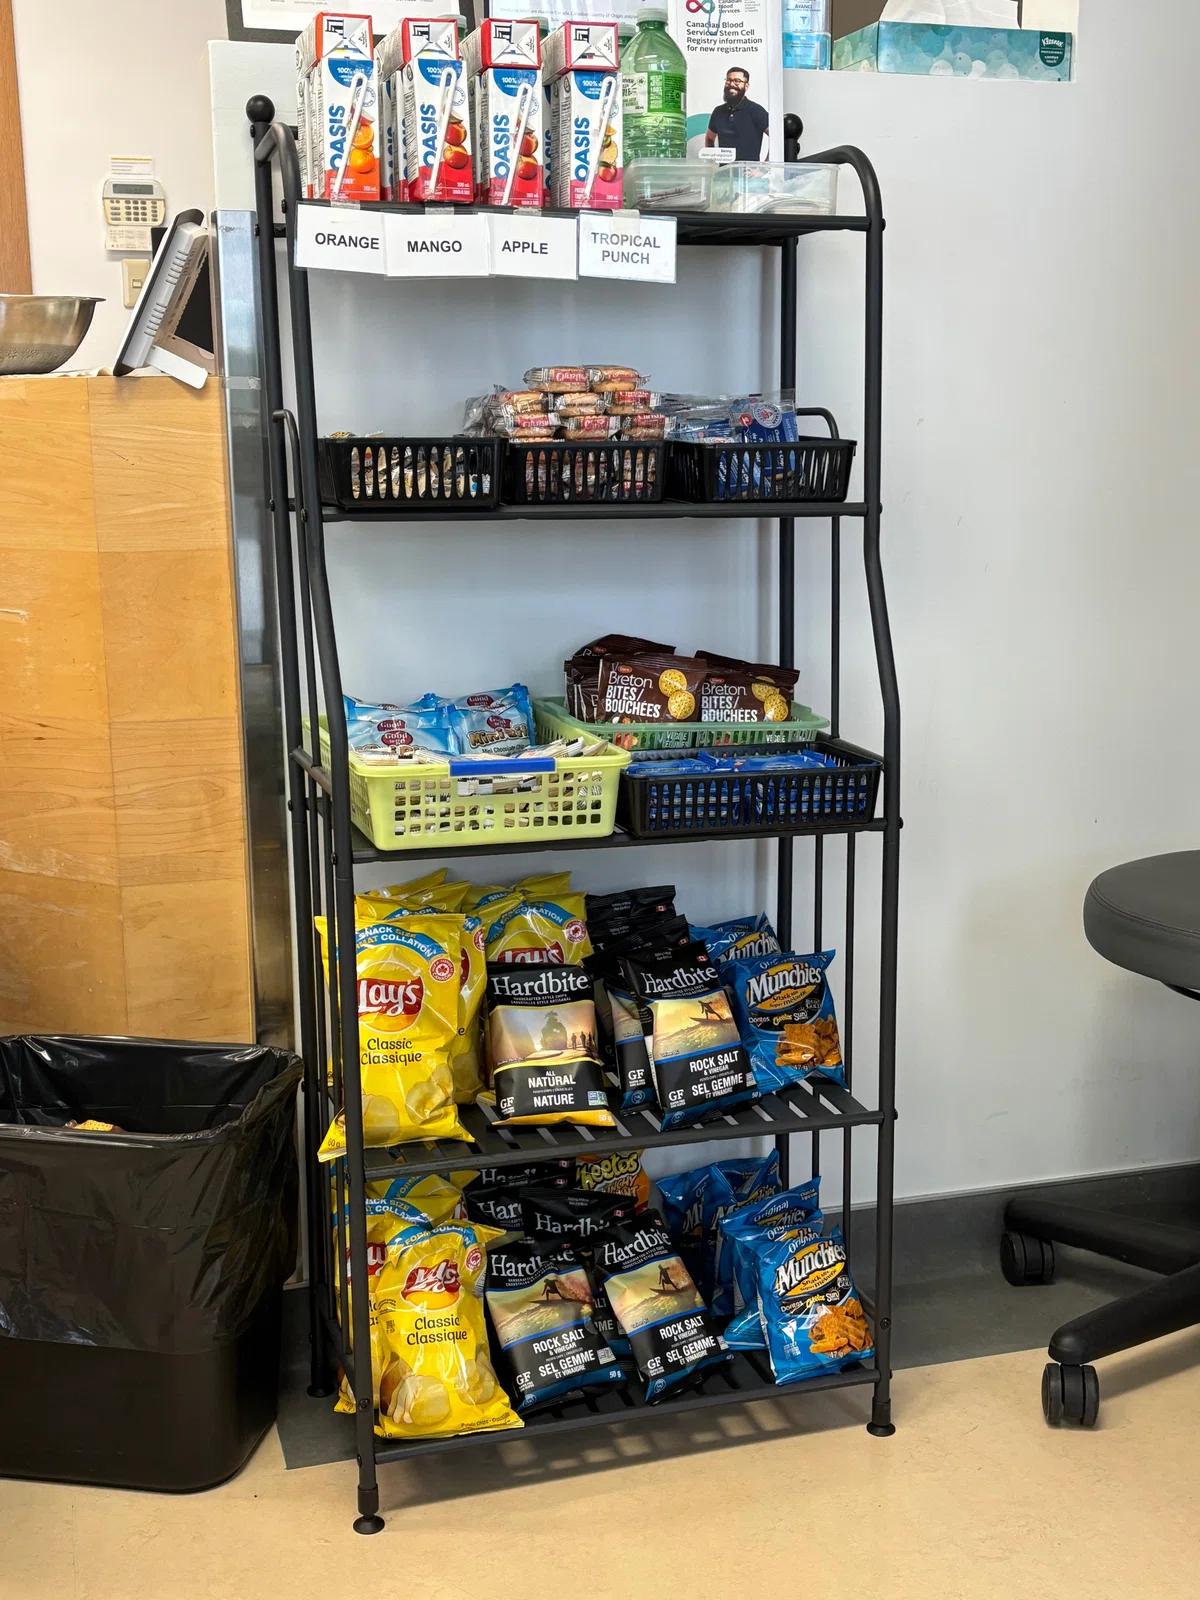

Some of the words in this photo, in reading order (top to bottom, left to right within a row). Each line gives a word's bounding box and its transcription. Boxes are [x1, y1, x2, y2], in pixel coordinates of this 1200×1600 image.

[687, 37, 717, 45] Registry
[717, 45, 759, 53] registrants
[329, 105, 347, 172] OASIS
[420, 104, 438, 168] OASIS
[493, 115, 510, 179] OASIS
[574, 117, 590, 182] OASIS
[315, 232, 380, 250] ORANGE
[407, 240, 462, 253] MANGO
[502, 240, 549, 254] APPLE
[591, 232, 661, 248] TROPICAL
[601, 250, 650, 265] PUNCH
[609, 671, 652, 688] Breton
[606, 685, 644, 701] BITES/
[702, 683, 746, 696] Breton
[606, 699, 661, 718] BOUCHÉES
[702, 696, 738, 709] BITES/
[702, 708, 757, 722] BOUCHÉES
[359, 926, 393, 939] SNACK
[381, 934, 433, 958] COLLATION
[491, 971, 589, 996] Hardbite
[641, 967, 718, 993] Hardbite
[748, 963, 821, 1007] Munchies
[358, 979, 420, 1017] Lay's
[772, 993, 790, 1003] Snack
[748, 1015, 770, 1023] Doritos
[367, 1038, 413, 1050] Classic
[360, 1052, 422, 1066] Classique
[689, 1057, 716, 1072] ROCK
[718, 1051, 739, 1065] SALT
[628, 1069, 645, 1080] GF
[709, 1064, 729, 1074] VINEGAR
[528, 1075, 576, 1088] NATURAL
[691, 1083, 710, 1096] SEL
[712, 1073, 743, 1091] GEMME
[533, 1094, 574, 1107] NATURE
[668, 1089, 685, 1101] GF
[501, 1097, 514, 1109] GF
[390, 1200, 410, 1211] SIZE
[754, 1200, 789, 1222] Original
[776, 1240, 846, 1296] Munchies
[802, 1274, 820, 1286] Snack
[781, 1300, 804, 1312] Doritos
[826, 1290, 840, 1302] Sun
[415, 1314, 460, 1330] Classic
[659, 1322, 685, 1339] ROCK
[684, 1316, 704, 1330] SALT
[407, 1329, 467, 1346] Classique
[678, 1328, 698, 1340] VINEGAR
[533, 1337, 561, 1354] ROCK
[562, 1329, 585, 1344] SALT
[554, 1342, 577, 1354] VINEGAR
[666, 1349, 683, 1363] SEL
[683, 1336, 716, 1357] GEMME
[686, 1350, 708, 1363] VINAIGRE
[538, 1364, 558, 1377] SEL
[560, 1349, 595, 1370] GEMME
[647, 1356, 661, 1370] GF
[562, 1364, 586, 1377] VINAIGRE
[609, 1370, 616, 1378] 50
[516, 1371, 531, 1385] GF
